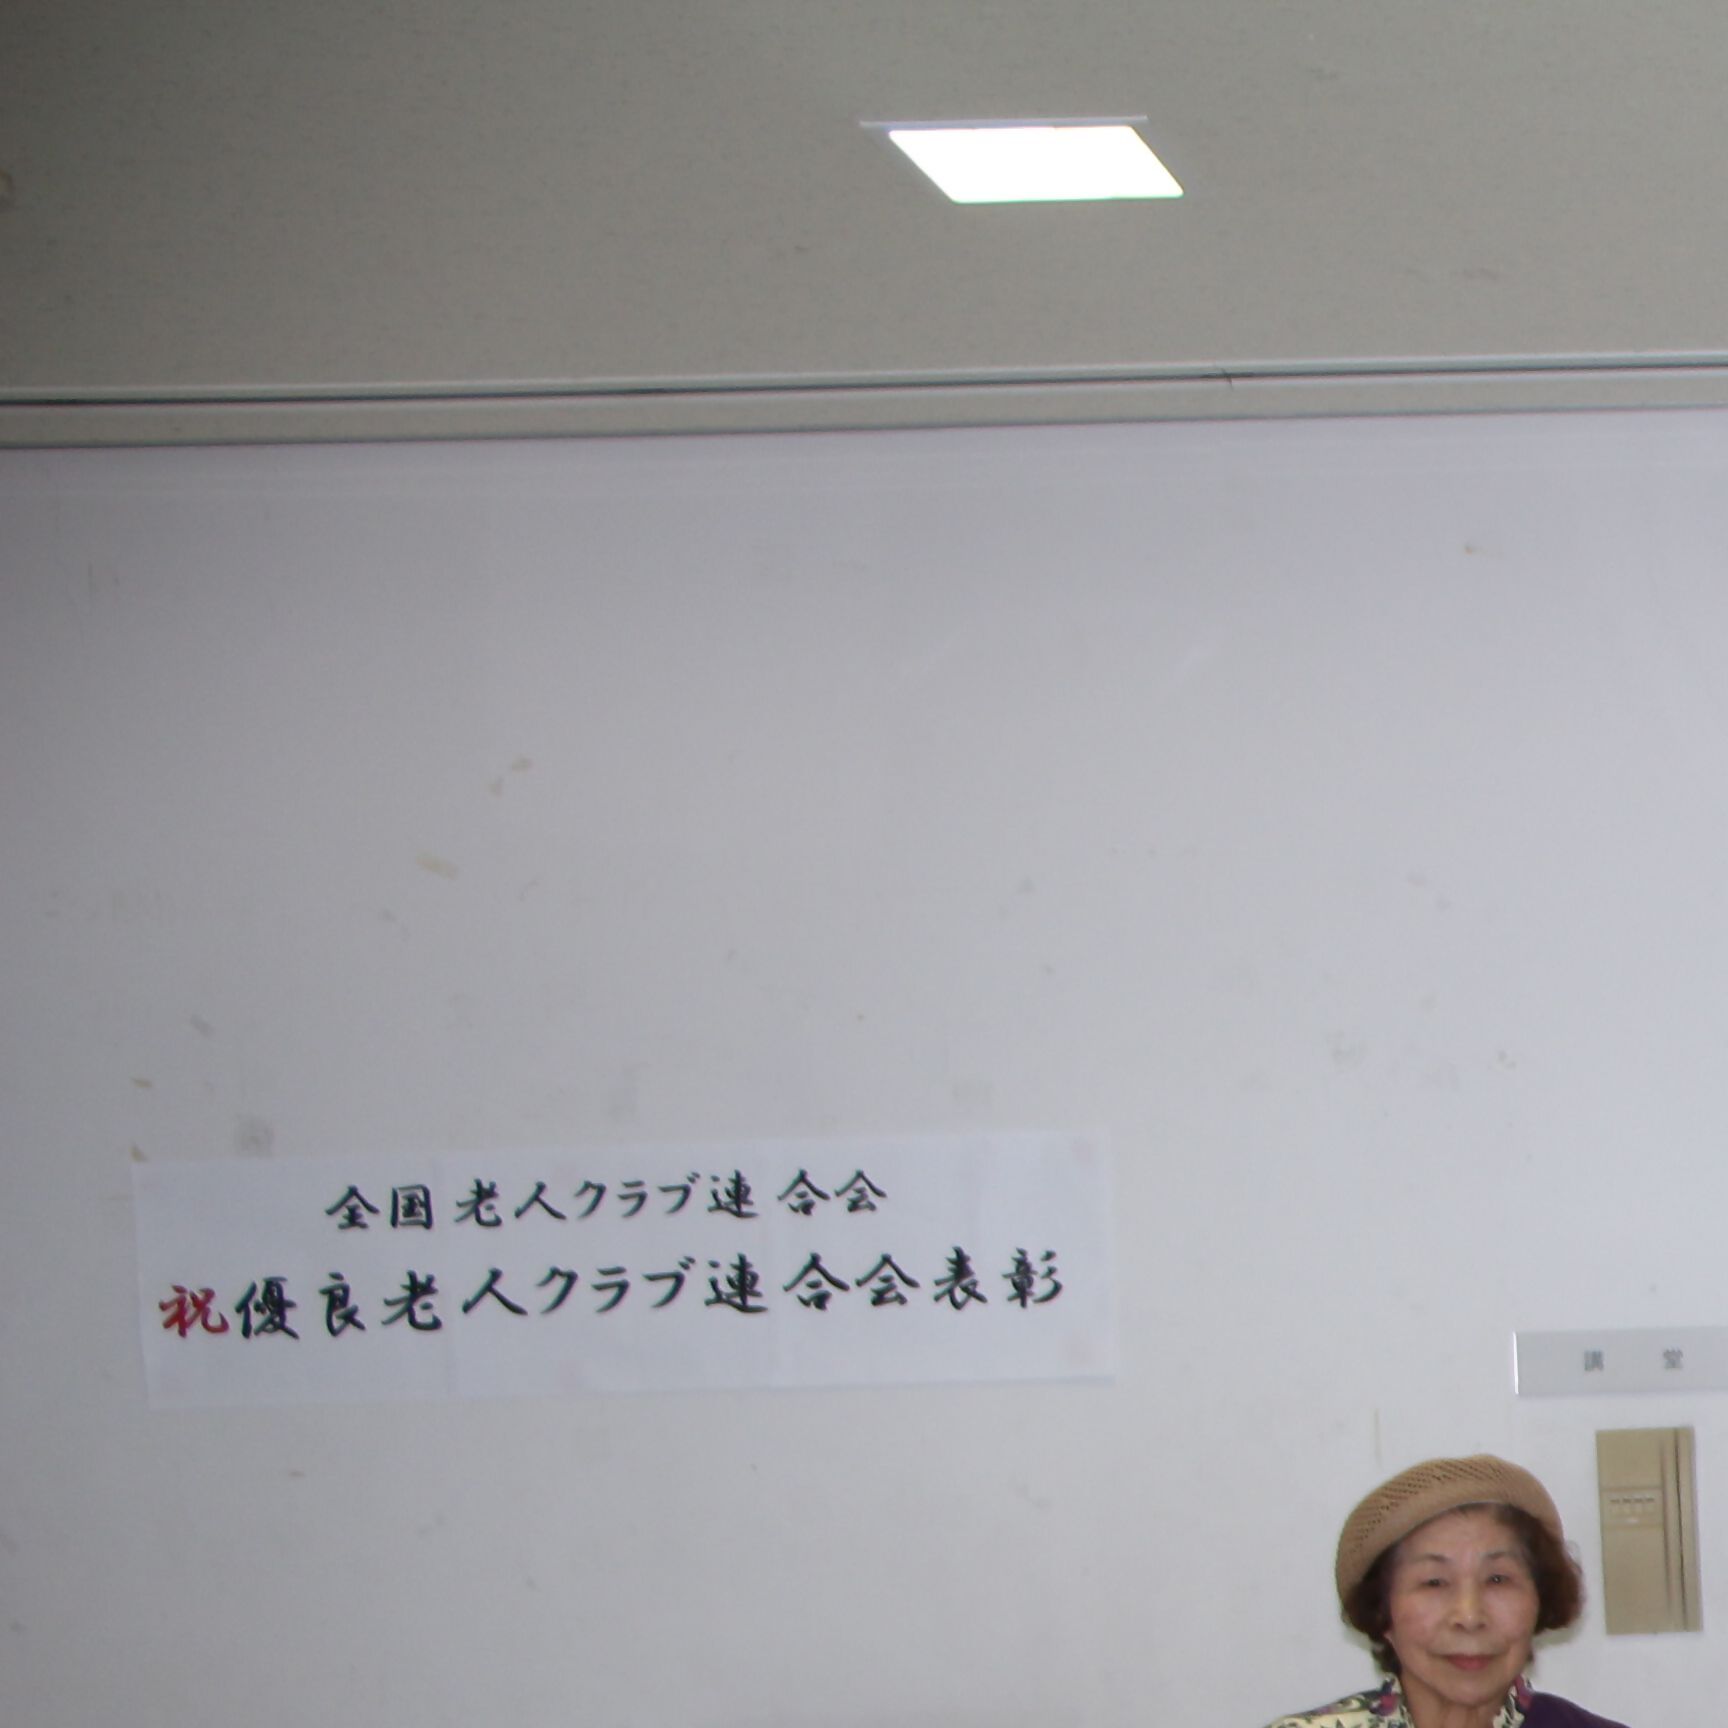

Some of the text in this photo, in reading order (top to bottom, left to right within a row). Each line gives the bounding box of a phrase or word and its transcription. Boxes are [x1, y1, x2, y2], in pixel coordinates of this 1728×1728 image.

[323, 1168, 889, 1232] 全国老人クラブ連合会
